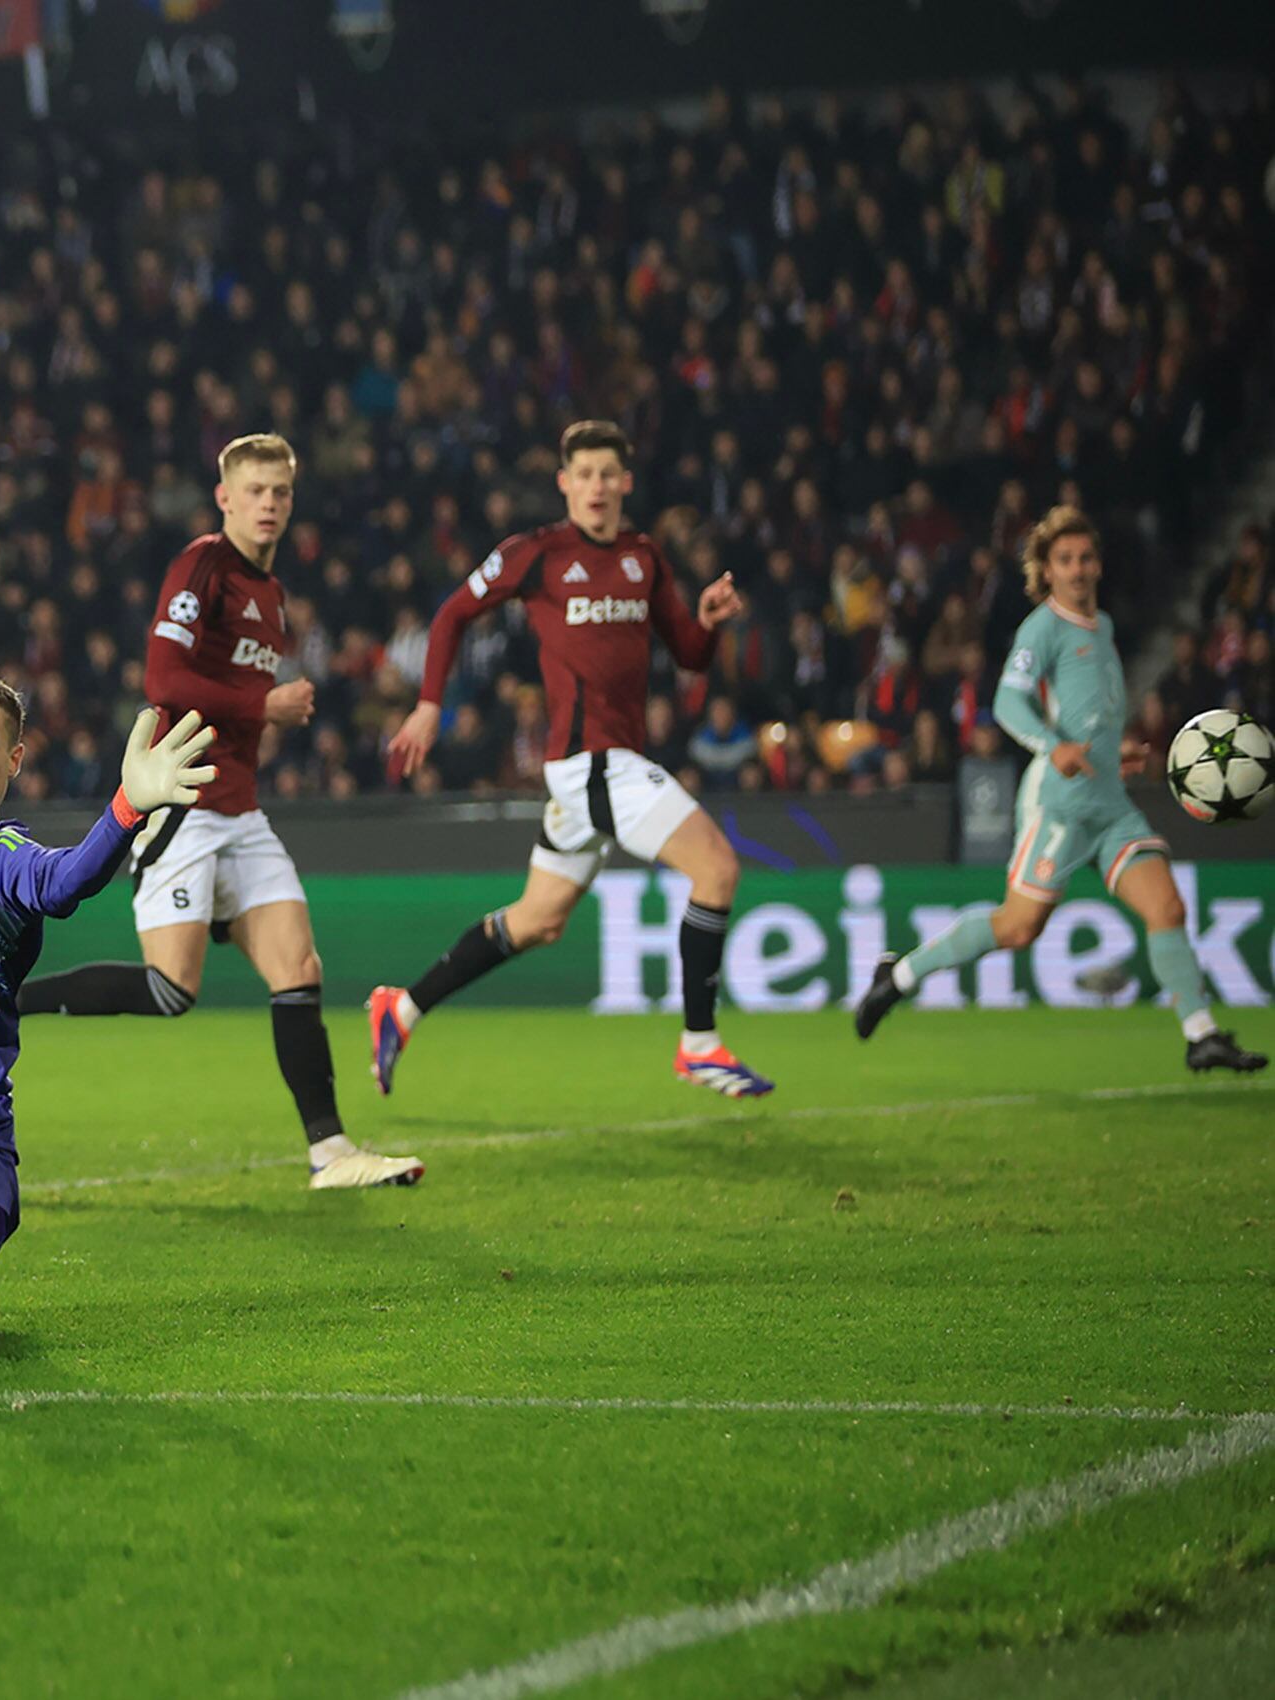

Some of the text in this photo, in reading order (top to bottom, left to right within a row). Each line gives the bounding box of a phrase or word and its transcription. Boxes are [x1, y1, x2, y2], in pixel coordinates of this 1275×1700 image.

[566, 595, 649, 626] Betano
[171, 887, 191, 910] S
[589, 860, 1275, 1016] Heinek
